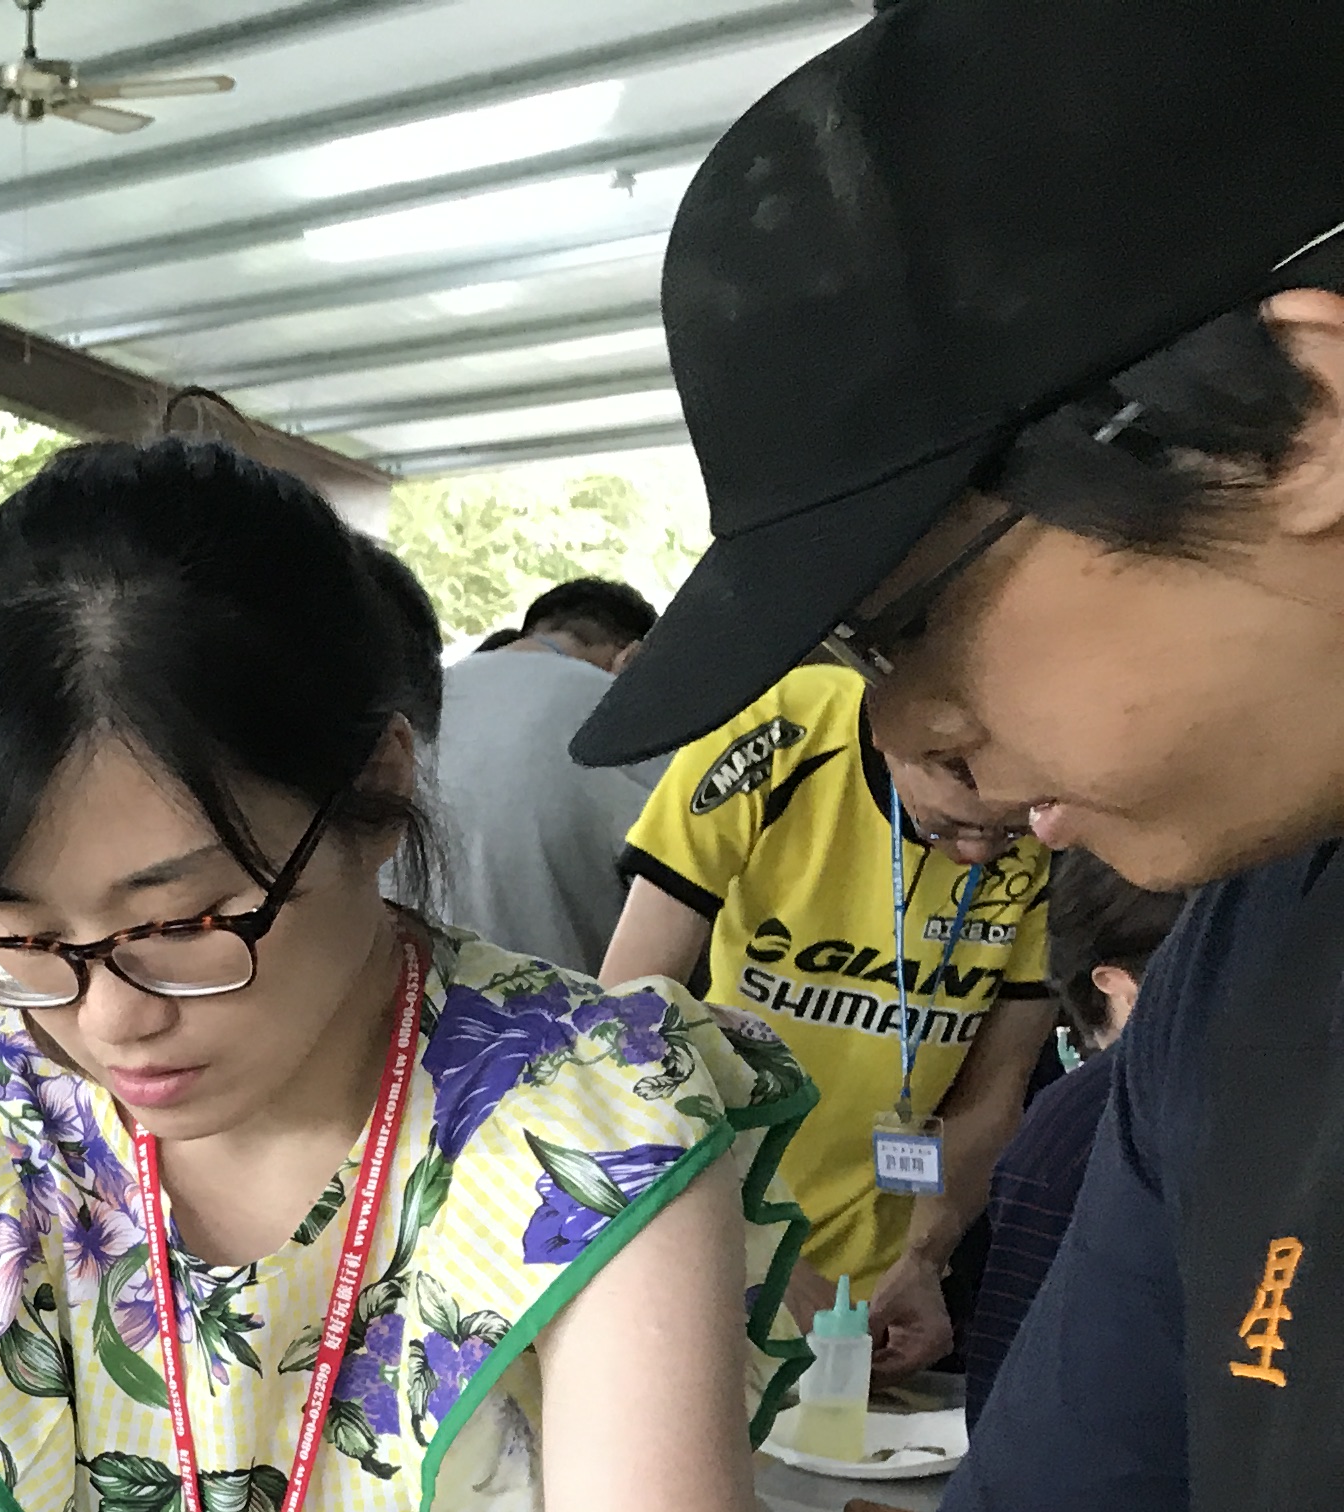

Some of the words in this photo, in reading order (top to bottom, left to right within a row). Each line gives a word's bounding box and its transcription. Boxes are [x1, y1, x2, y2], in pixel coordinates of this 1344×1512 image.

[794, 939, 1006, 1000] GIANT
[353, 1052, 408, 1247] www.funtour.com.tw
[138, 1143, 170, 1333] www.funtour.com.tw
[323, 1251, 363, 1351] 好好玩旅行社
[298, 1362, 332, 1461] 0800-053299
